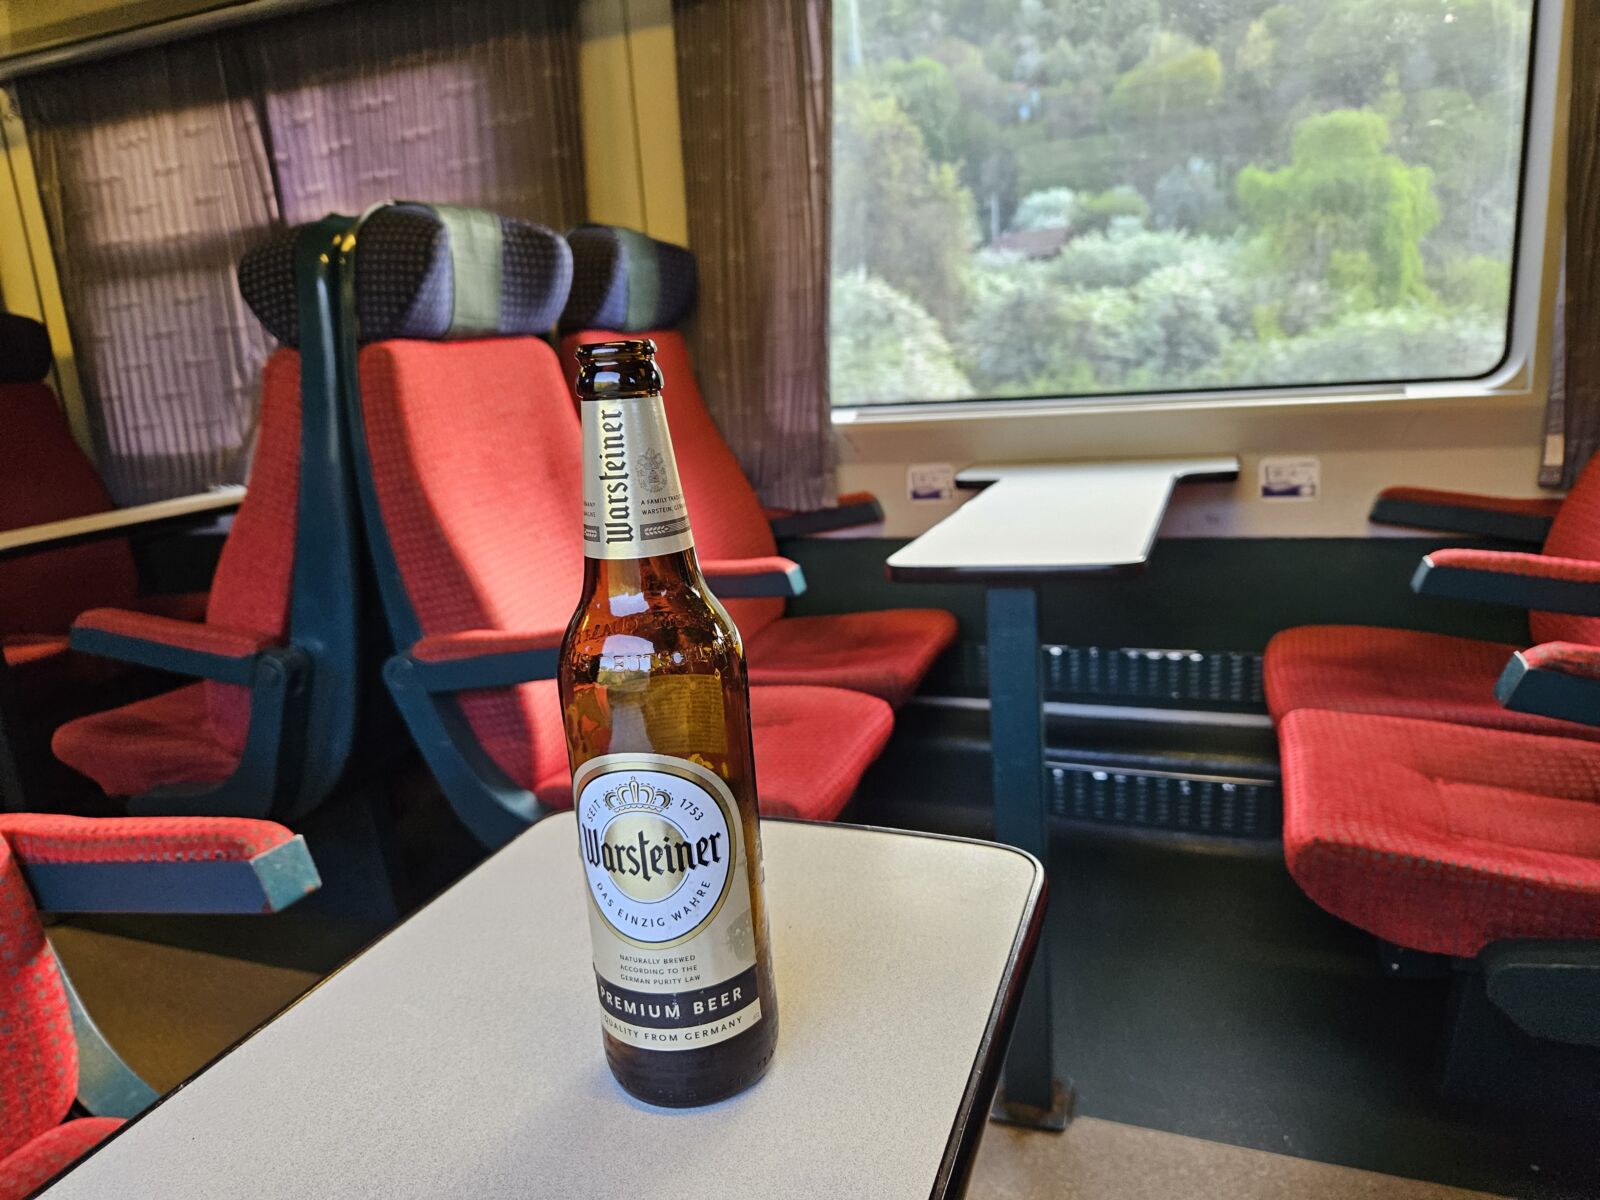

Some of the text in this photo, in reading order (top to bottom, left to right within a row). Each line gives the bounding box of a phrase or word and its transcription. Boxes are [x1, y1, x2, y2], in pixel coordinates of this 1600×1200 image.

[599, 409, 634, 545] Warsteiner
[587, 799, 601, 822] SEIT
[679, 798, 704, 821] 1753
[582, 823, 721, 882] Warsteiner
[597, 881, 711, 928] DAS EINZIG WAHRE
[619, 954, 696, 965] NATURALLY BREWED
[620, 964, 665, 975] ACCORDING
[682, 964, 698, 973] THE
[620, 974, 701, 985] GERMAN PURITY LAW
[600, 985, 742, 1018] PREMIUM BEER
[603, 1014, 743, 1042] QUALITY FROM GERMANY
